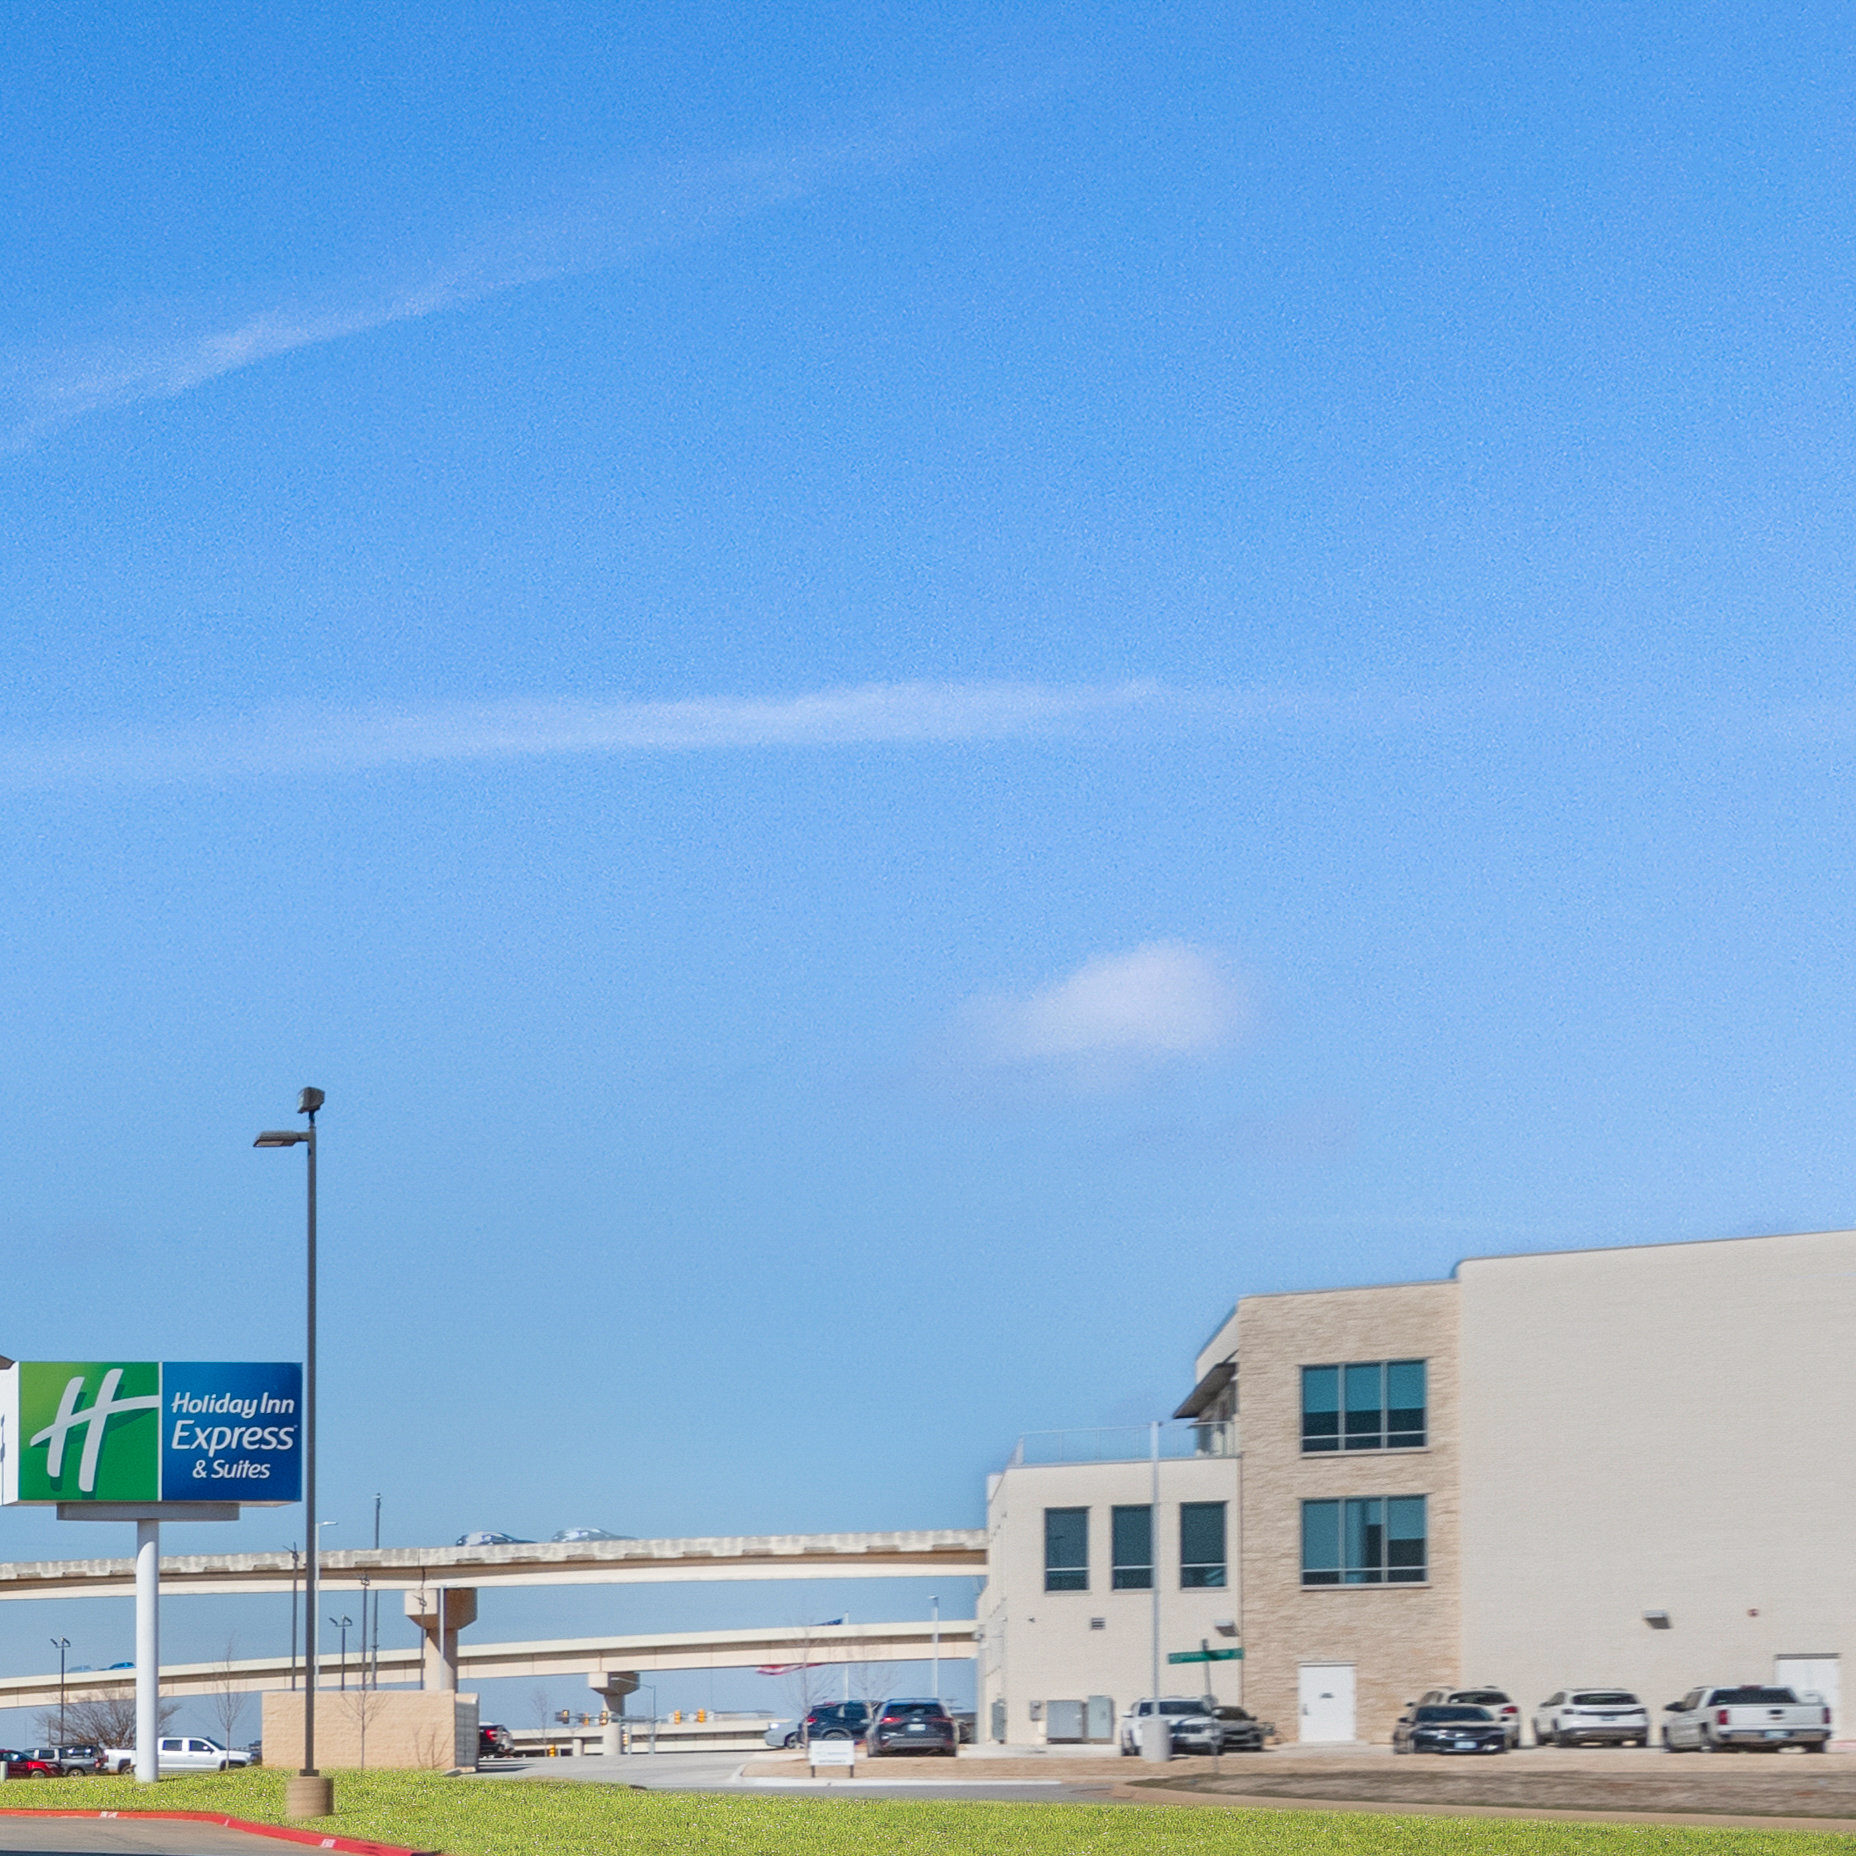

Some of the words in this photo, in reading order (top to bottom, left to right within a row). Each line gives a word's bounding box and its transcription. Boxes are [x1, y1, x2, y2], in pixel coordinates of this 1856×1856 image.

[171, 1391, 257, 1419] Holiday
[260, 1391, 295, 1414] Inn
[171, 1419, 295, 1458] Express
[192, 1459, 207, 1479] &
[211, 1459, 271, 1479] Suites
